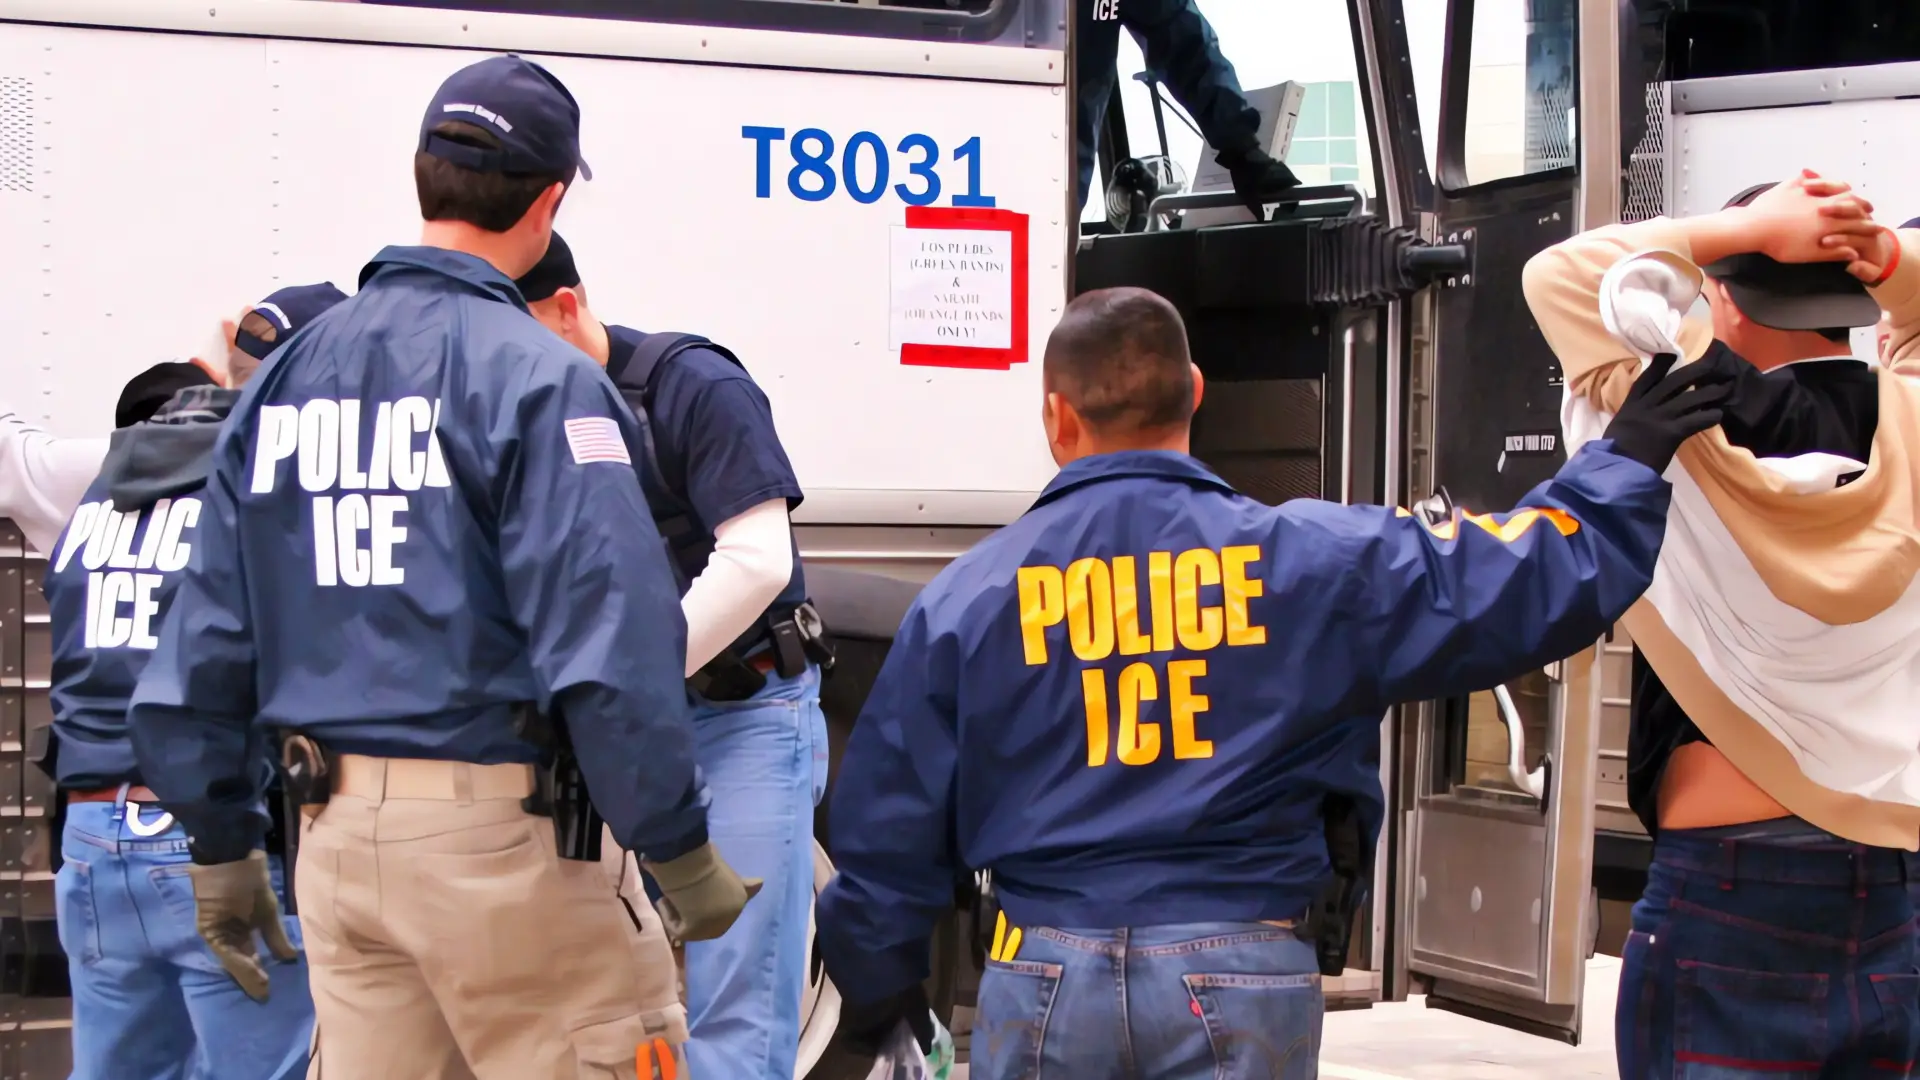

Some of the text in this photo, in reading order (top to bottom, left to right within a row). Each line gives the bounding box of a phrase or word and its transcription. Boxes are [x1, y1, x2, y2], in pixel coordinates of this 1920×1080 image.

[1092, 0, 1120, 21] ICE
[742, 125, 996, 208] T8031
[952, 277, 961, 288] &
[54, 498, 203, 573] POLIC
[312, 493, 409, 587] ICE
[84, 571, 164, 650] ICE
[1017, 545, 1267, 665] POLICE
[1081, 659, 1214, 767] ICE
